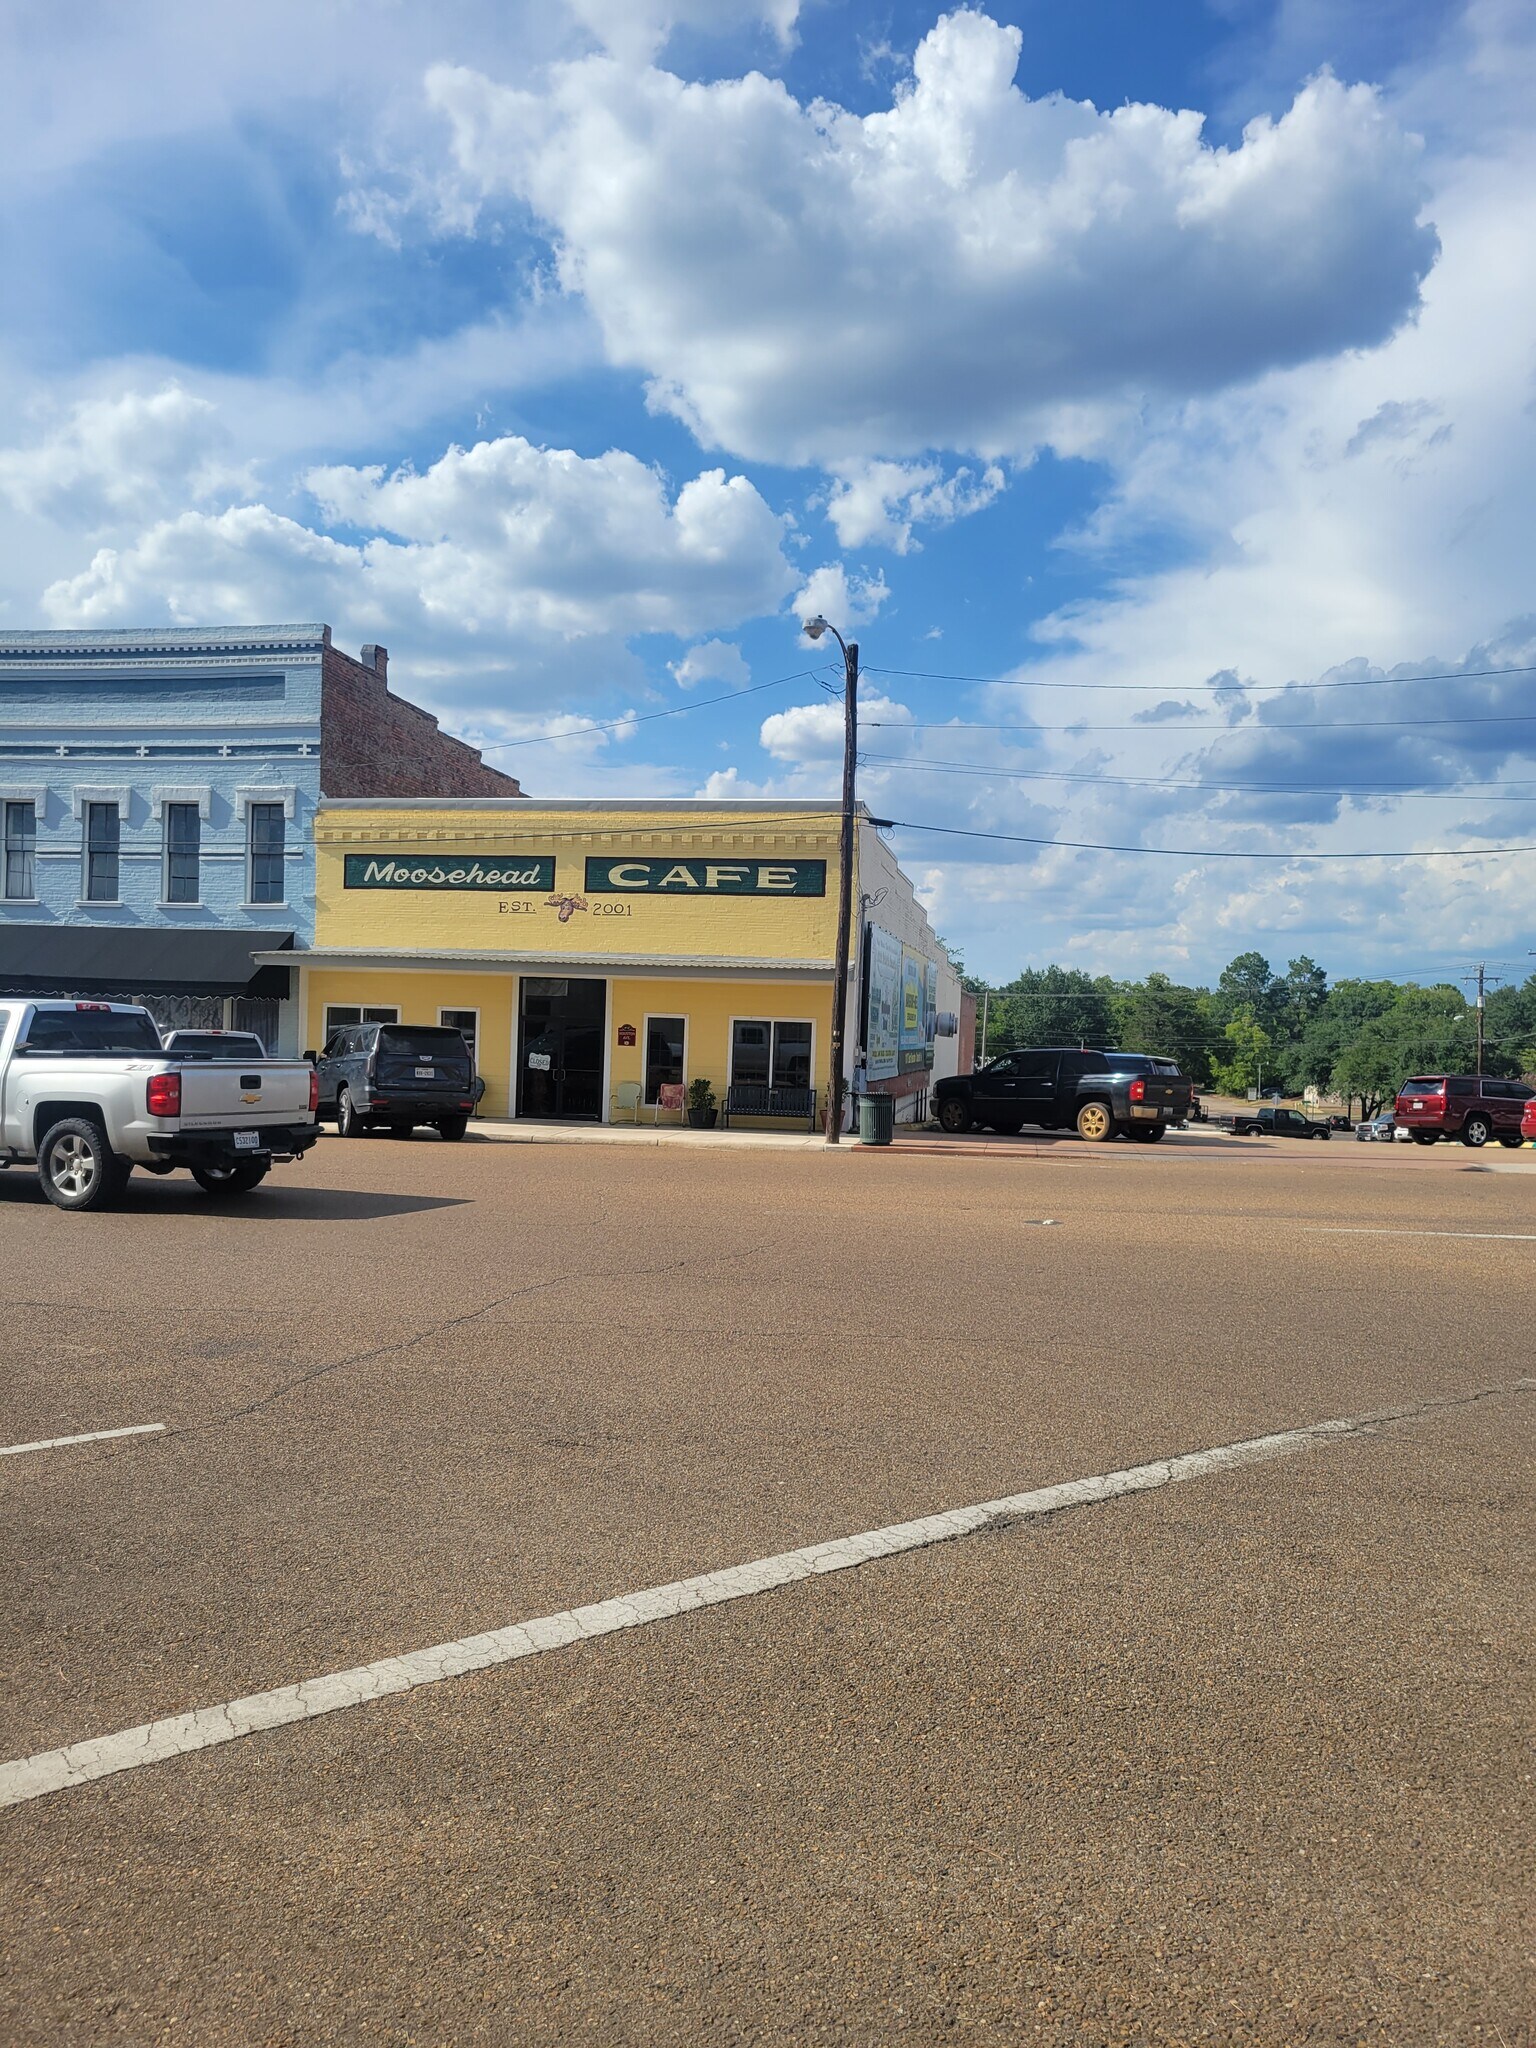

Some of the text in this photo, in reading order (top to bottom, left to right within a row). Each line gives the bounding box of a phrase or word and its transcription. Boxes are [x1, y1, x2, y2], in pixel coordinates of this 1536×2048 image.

[364, 861, 541, 885] Moosehead
[608, 863, 798, 889] CAFE
[498, 901, 632, 916] EST. 2001
[530, 1057, 549, 1066] CLOSED
